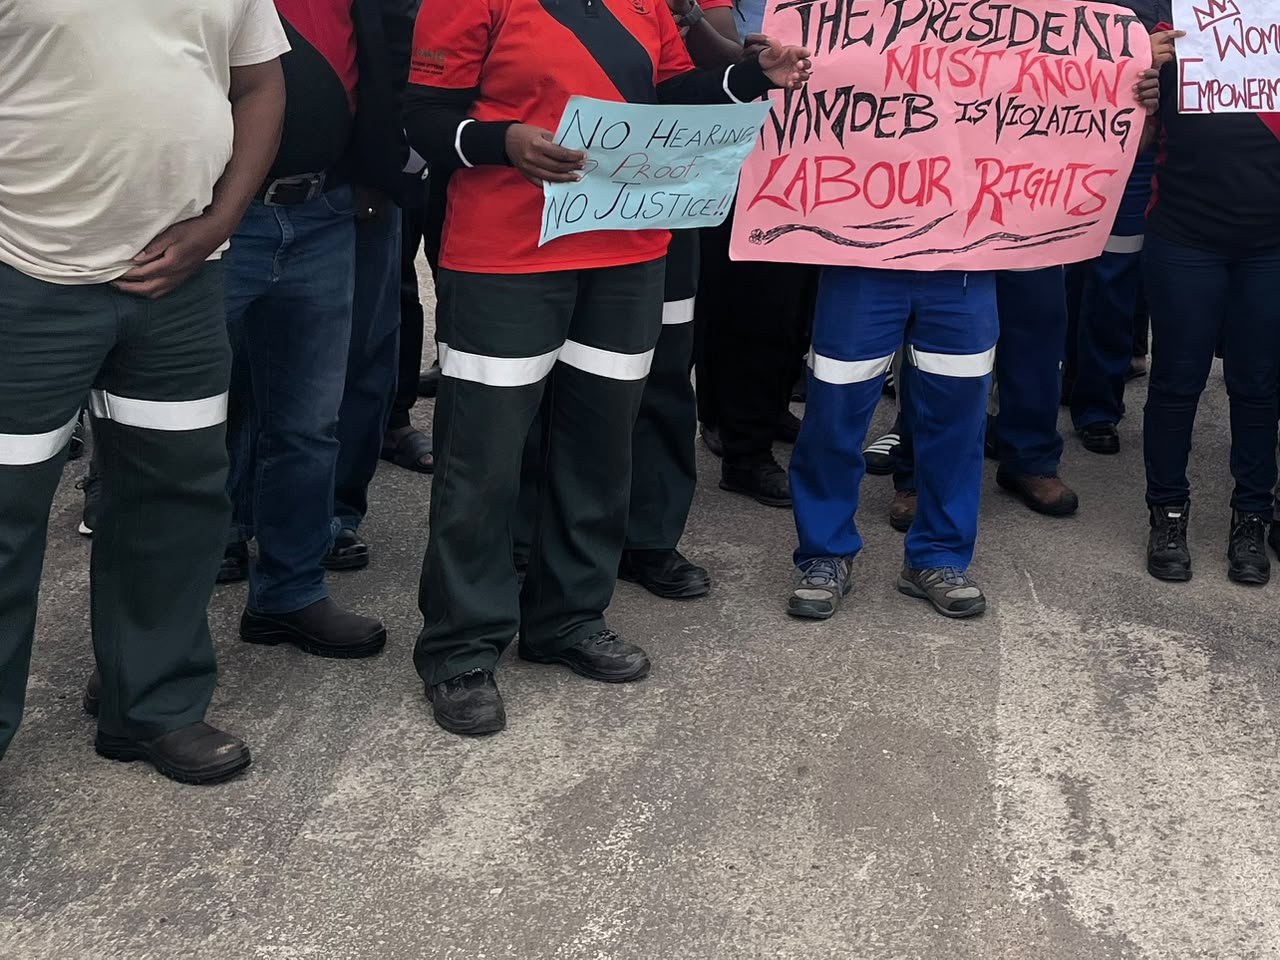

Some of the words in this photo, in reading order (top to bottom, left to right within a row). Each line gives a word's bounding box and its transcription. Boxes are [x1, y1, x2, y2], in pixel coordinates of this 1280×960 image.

[884, 42, 1004, 95] MUST
[1008, 47, 1130, 108] KNOW
[558, 109, 631, 150] NO
[760, 81, 939, 156] NAMDEB
[954, 97, 990, 124] IS
[995, 92, 1136, 153] VIOLATING
[543, 192, 589, 238] NO
[594, 180, 733, 220] JUSTICE!!
[747, 154, 954, 217] LABOUR
[962, 157, 1119, 237] RIGHTS
